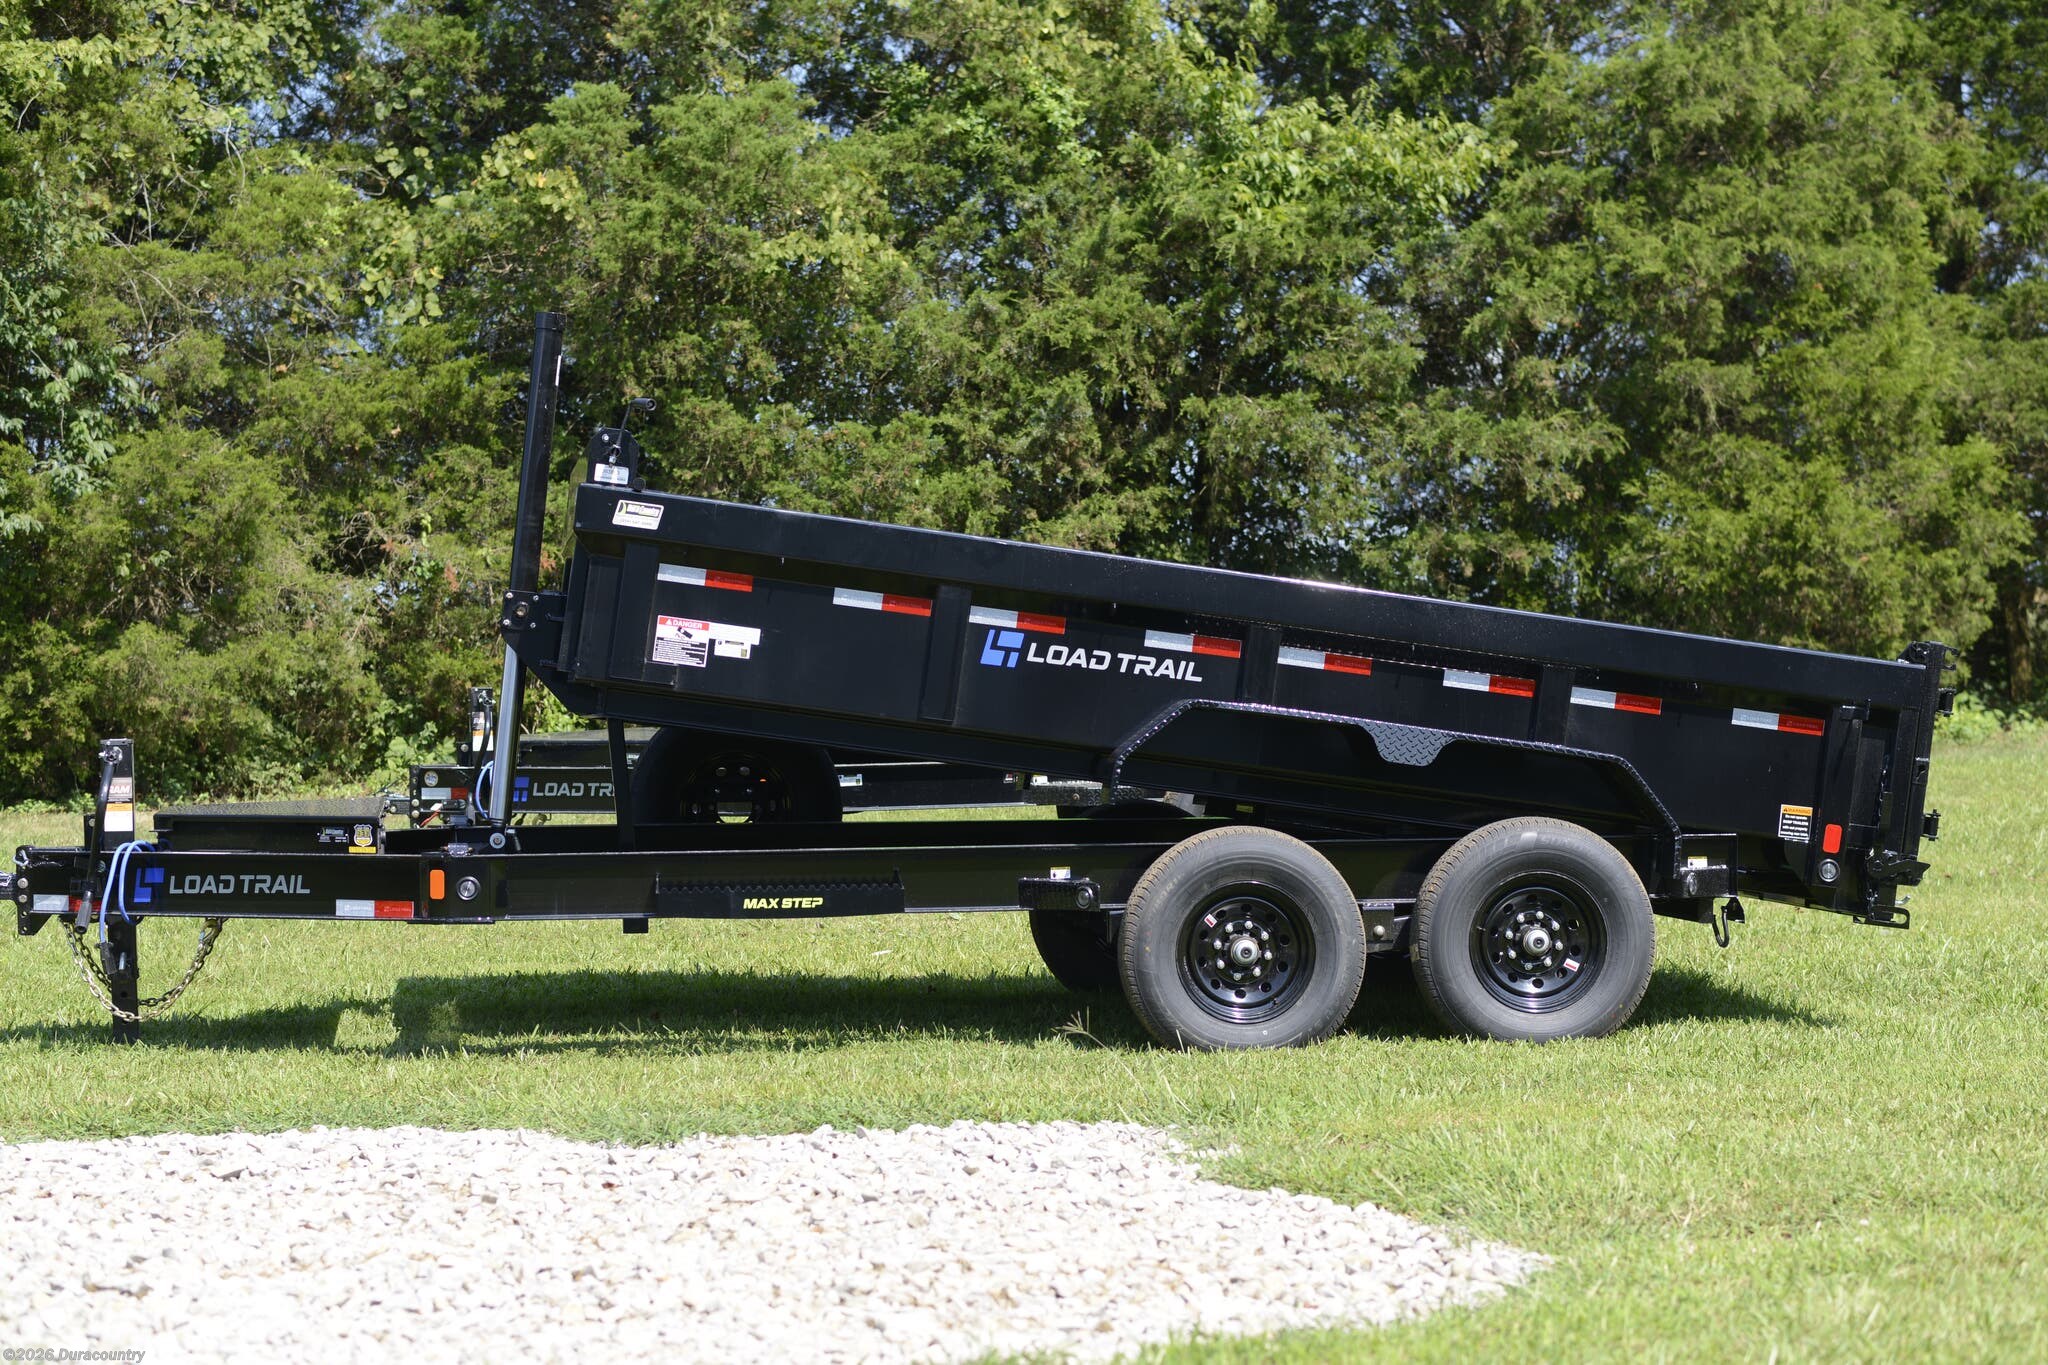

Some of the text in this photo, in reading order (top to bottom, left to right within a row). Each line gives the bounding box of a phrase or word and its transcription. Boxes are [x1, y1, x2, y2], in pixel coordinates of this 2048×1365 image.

[672, 619, 703, 630] DANGER
[1026, 642, 1203, 683] LOAD TRAIL
[533, 782, 585, 797] LOAD
[169, 874, 311, 895] LOAD TRAIL
[742, 897, 824, 910] MAX STEP
